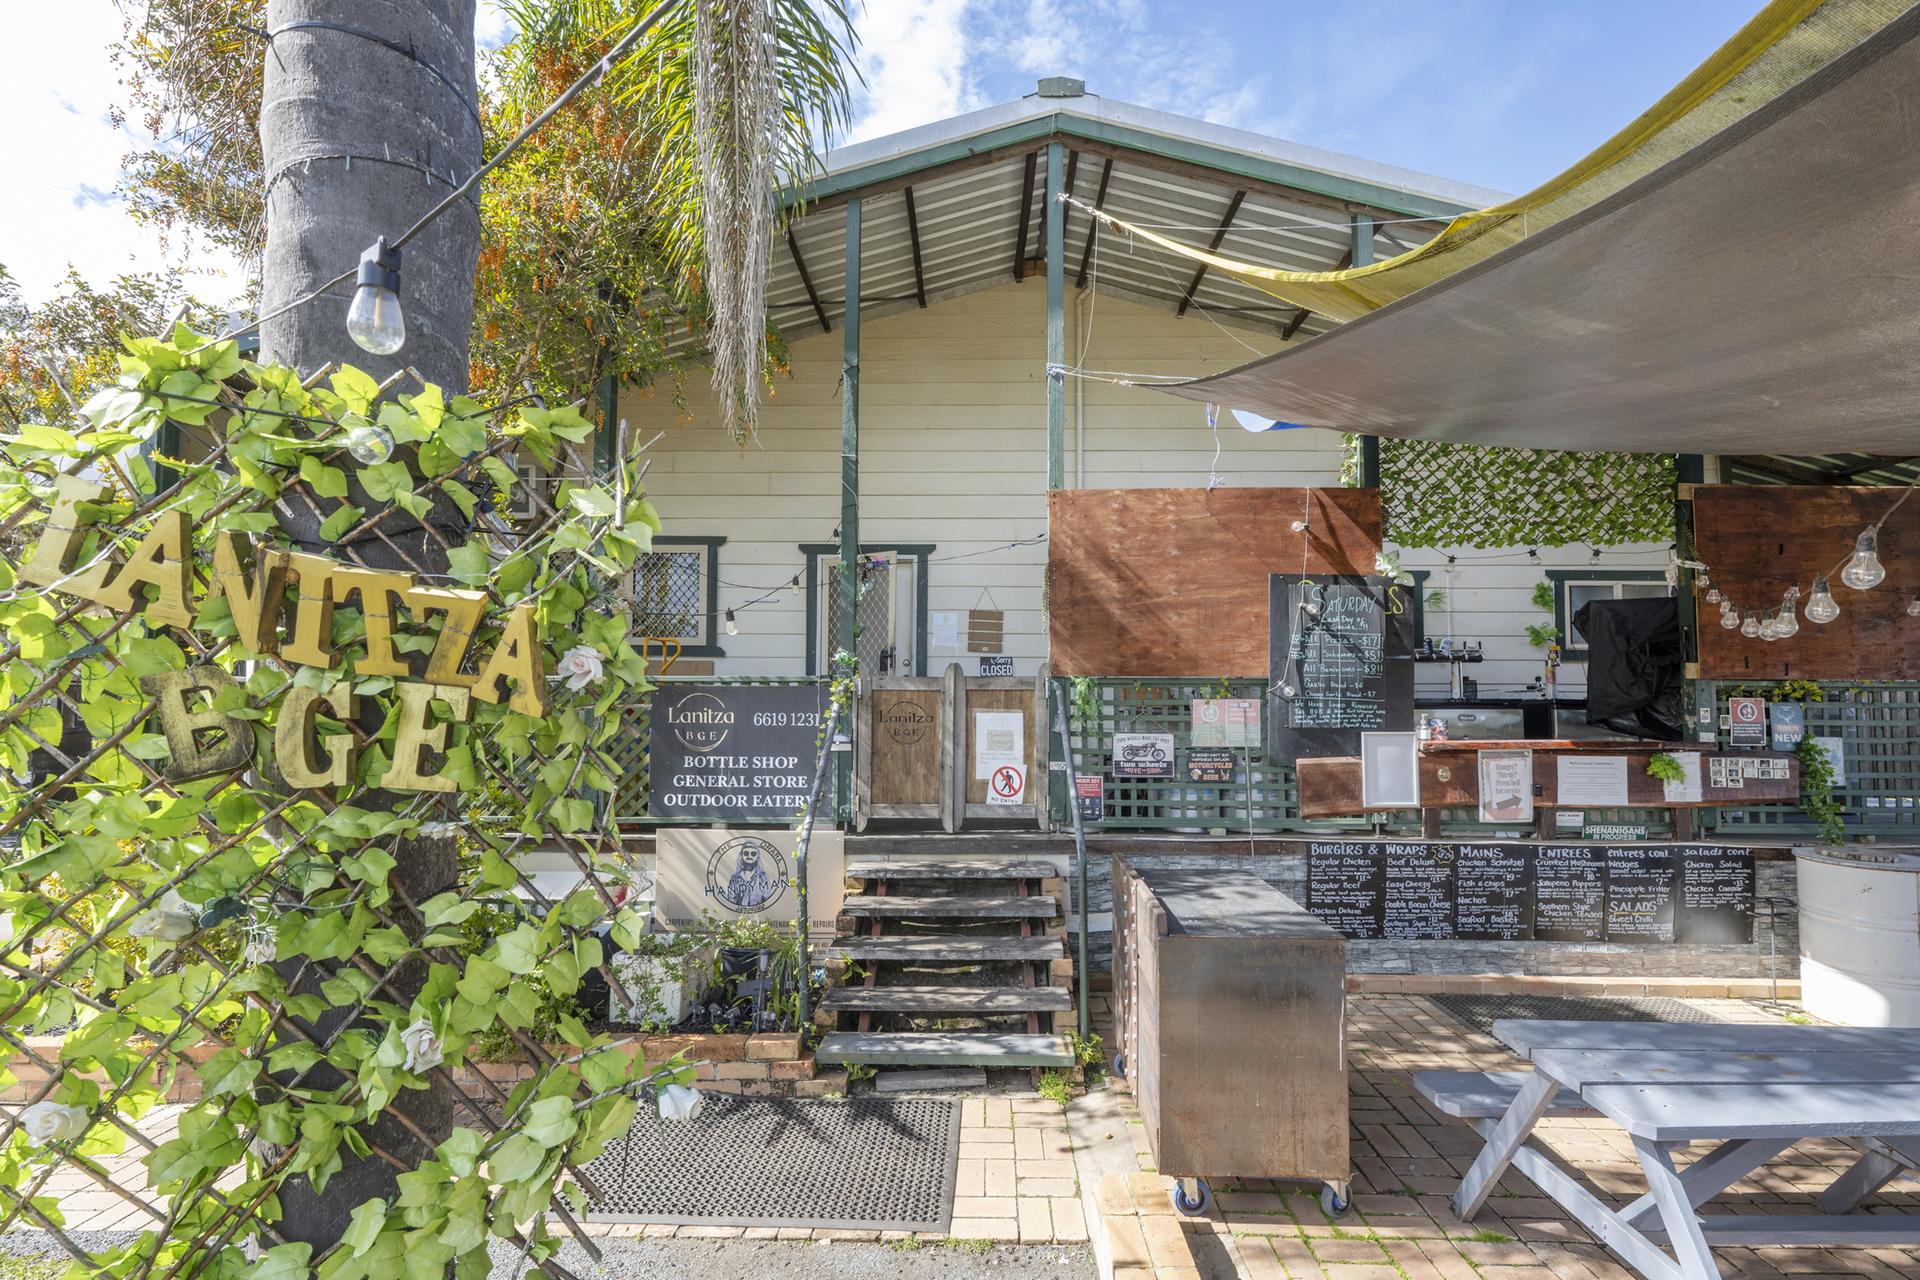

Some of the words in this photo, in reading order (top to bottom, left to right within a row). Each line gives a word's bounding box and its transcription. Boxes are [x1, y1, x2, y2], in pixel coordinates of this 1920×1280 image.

[17, 474, 552, 718] LANITZA
[1312, 587, 1377, 614] SATURDAY
[1341, 616, 1354, 624] Day
[1304, 634, 1317, 642] All
[1323, 634, 1354, 644] Pizzas
[1304, 649, 1316, 658] All
[996, 657, 1012, 665] Sorry
[980, 665, 1012, 676] CLOSED
[1304, 664, 1316, 672] All
[668, 707, 734, 724] Lanitza
[754, 712, 787, 727] 6619
[790, 712, 820, 727] 1231
[879, 710, 934, 723] Lanitza
[1775, 733, 1802, 743] NEW
[683, 755, 748, 768] BOTTLE
[752, 756, 798, 768] SHOP
[1496, 763, 1518, 771] Hungry?
[673, 774, 750, 788] GENERAL
[753, 776, 808, 788] STORE
[664, 794, 748, 806] OUTDOOR
[1585, 826, 1645, 835] SHENANIGANS
[716, 841, 732, 856] THE
[758, 841, 784, 864] ORARA
[1311, 844, 1363, 855] BURGERS
[1368, 844, 1378, 855] &
[1386, 844, 1428, 855] WRAPS
[1460, 846, 1504, 858] MAINS
[1538, 846, 1591, 858] ENTREES
[1607, 849, 1645, 858] entrees
[1683, 848, 1723, 856] salads
[1311, 857, 1340, 868] Regular
[1491, 858, 1524, 866] Schnitzel
[1608, 860, 1639, 869] Wedges
[1719, 860, 1742, 868] Salad
[704, 878, 790, 897] HANDYMAN
[1311, 882, 1340, 892] Regular
[1386, 881, 1404, 890] Easy
[1484, 881, 1505, 889] chips
[1572, 880, 1601, 888] Poppers
[1610, 885, 1645, 894] Pineapple
[1538, 902, 1570, 910] Southern
[1573, 902, 1591, 912] Style
[1608, 901, 1657, 912] SALADS
[813, 920, 835, 928] REPAIRS
[1412, 920, 1426, 928] Style
[1458, 915, 1485, 924] Seafood
[1491, 915, 1519, 924] Basket
